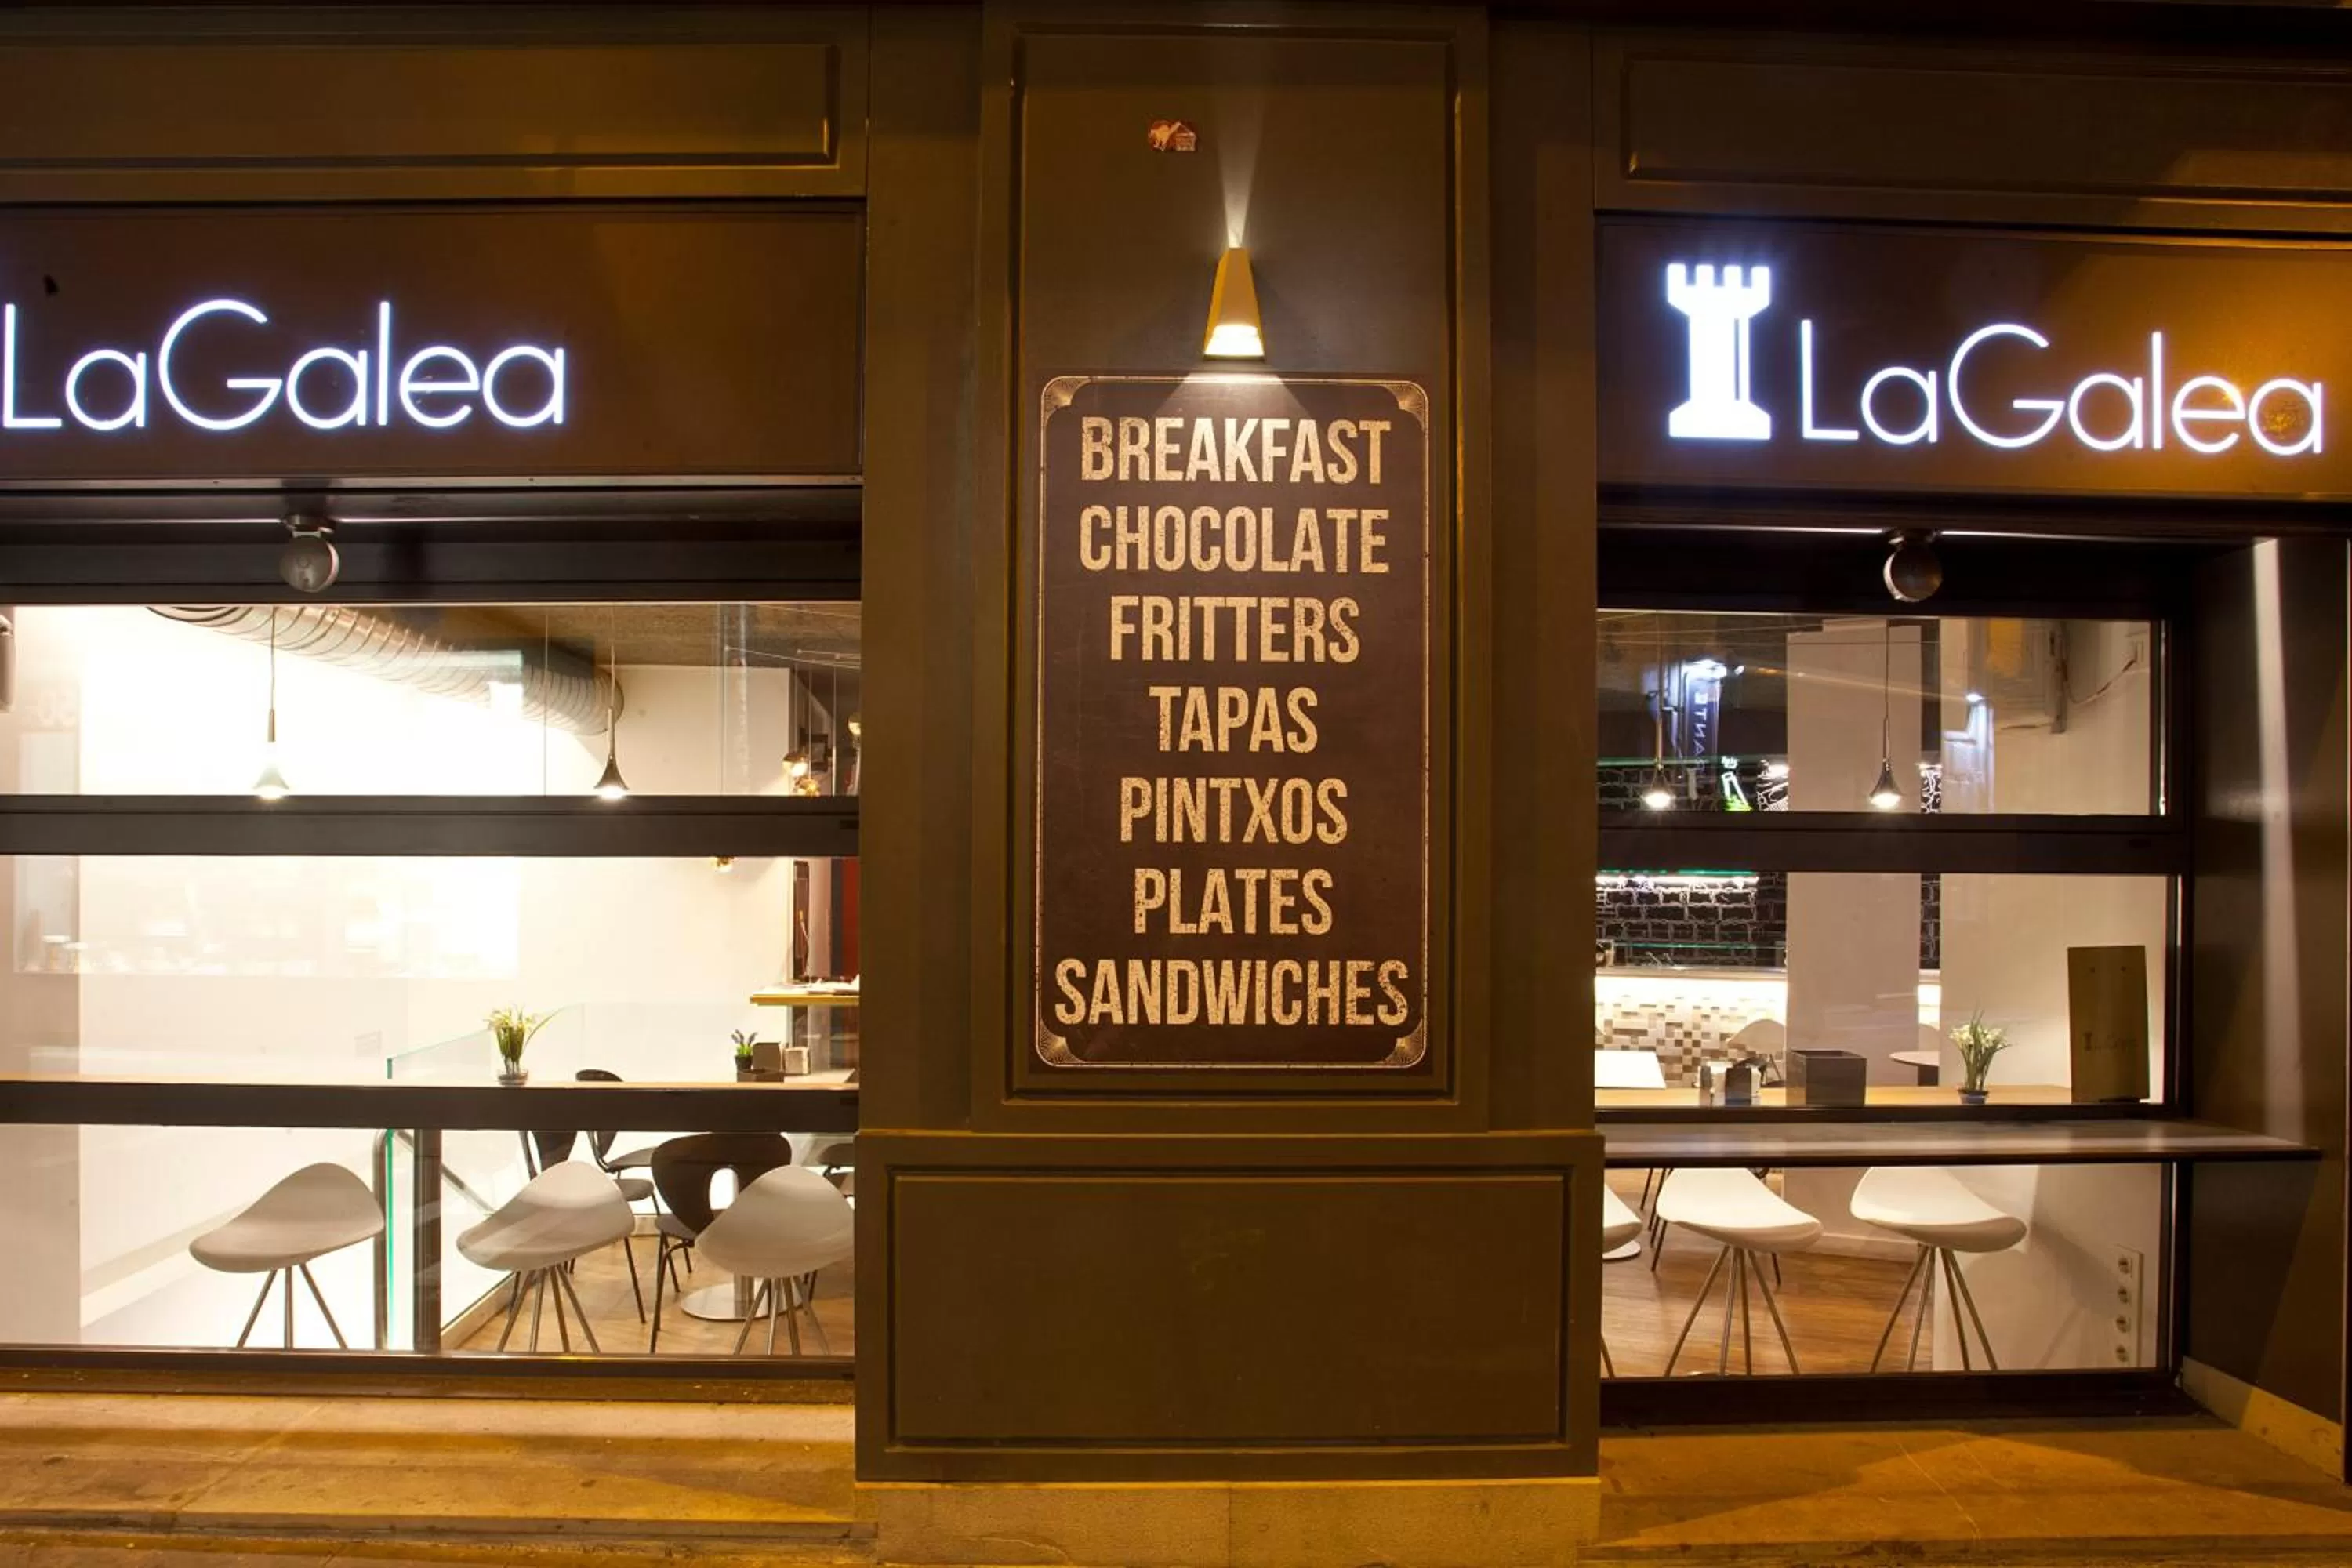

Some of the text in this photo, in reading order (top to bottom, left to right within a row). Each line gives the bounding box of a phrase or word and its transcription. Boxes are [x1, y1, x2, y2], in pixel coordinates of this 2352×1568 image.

[2, 299, 565, 430] LaGalea
[1801, 318, 2323, 456] LaGalea
[1080, 416, 1392, 485] BREAKFAST
[1079, 505, 1390, 574] CHOCOLATE
[1110, 595, 1360, 664] FRITTERS
[1149, 686, 1319, 753] TAPAS
[1120, 777, 1348, 844] PINTXOS
[1134, 867, 1334, 935] PLATES
[1054, 958, 1409, 1026] SANDWICHES
